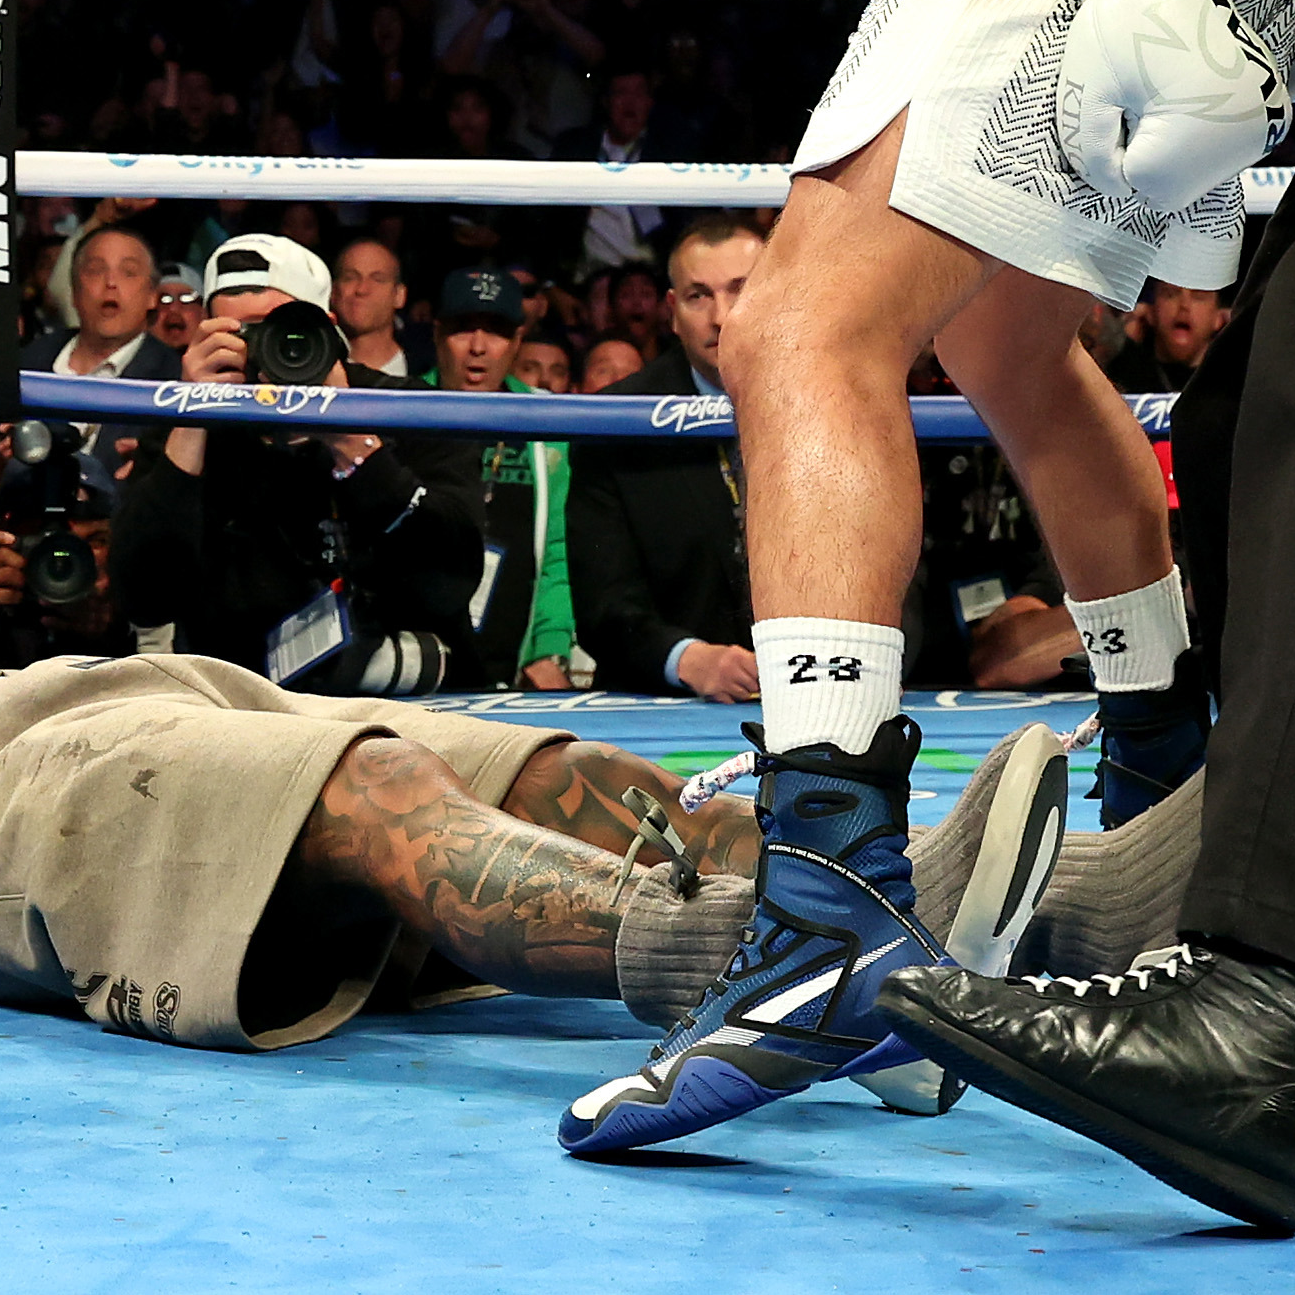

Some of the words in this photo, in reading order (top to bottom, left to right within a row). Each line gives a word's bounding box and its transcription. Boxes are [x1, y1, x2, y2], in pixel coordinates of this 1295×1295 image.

[154, 380, 254, 414] Golden
[276, 385, 338, 415] Boy
[788, 654, 862, 684] 23
